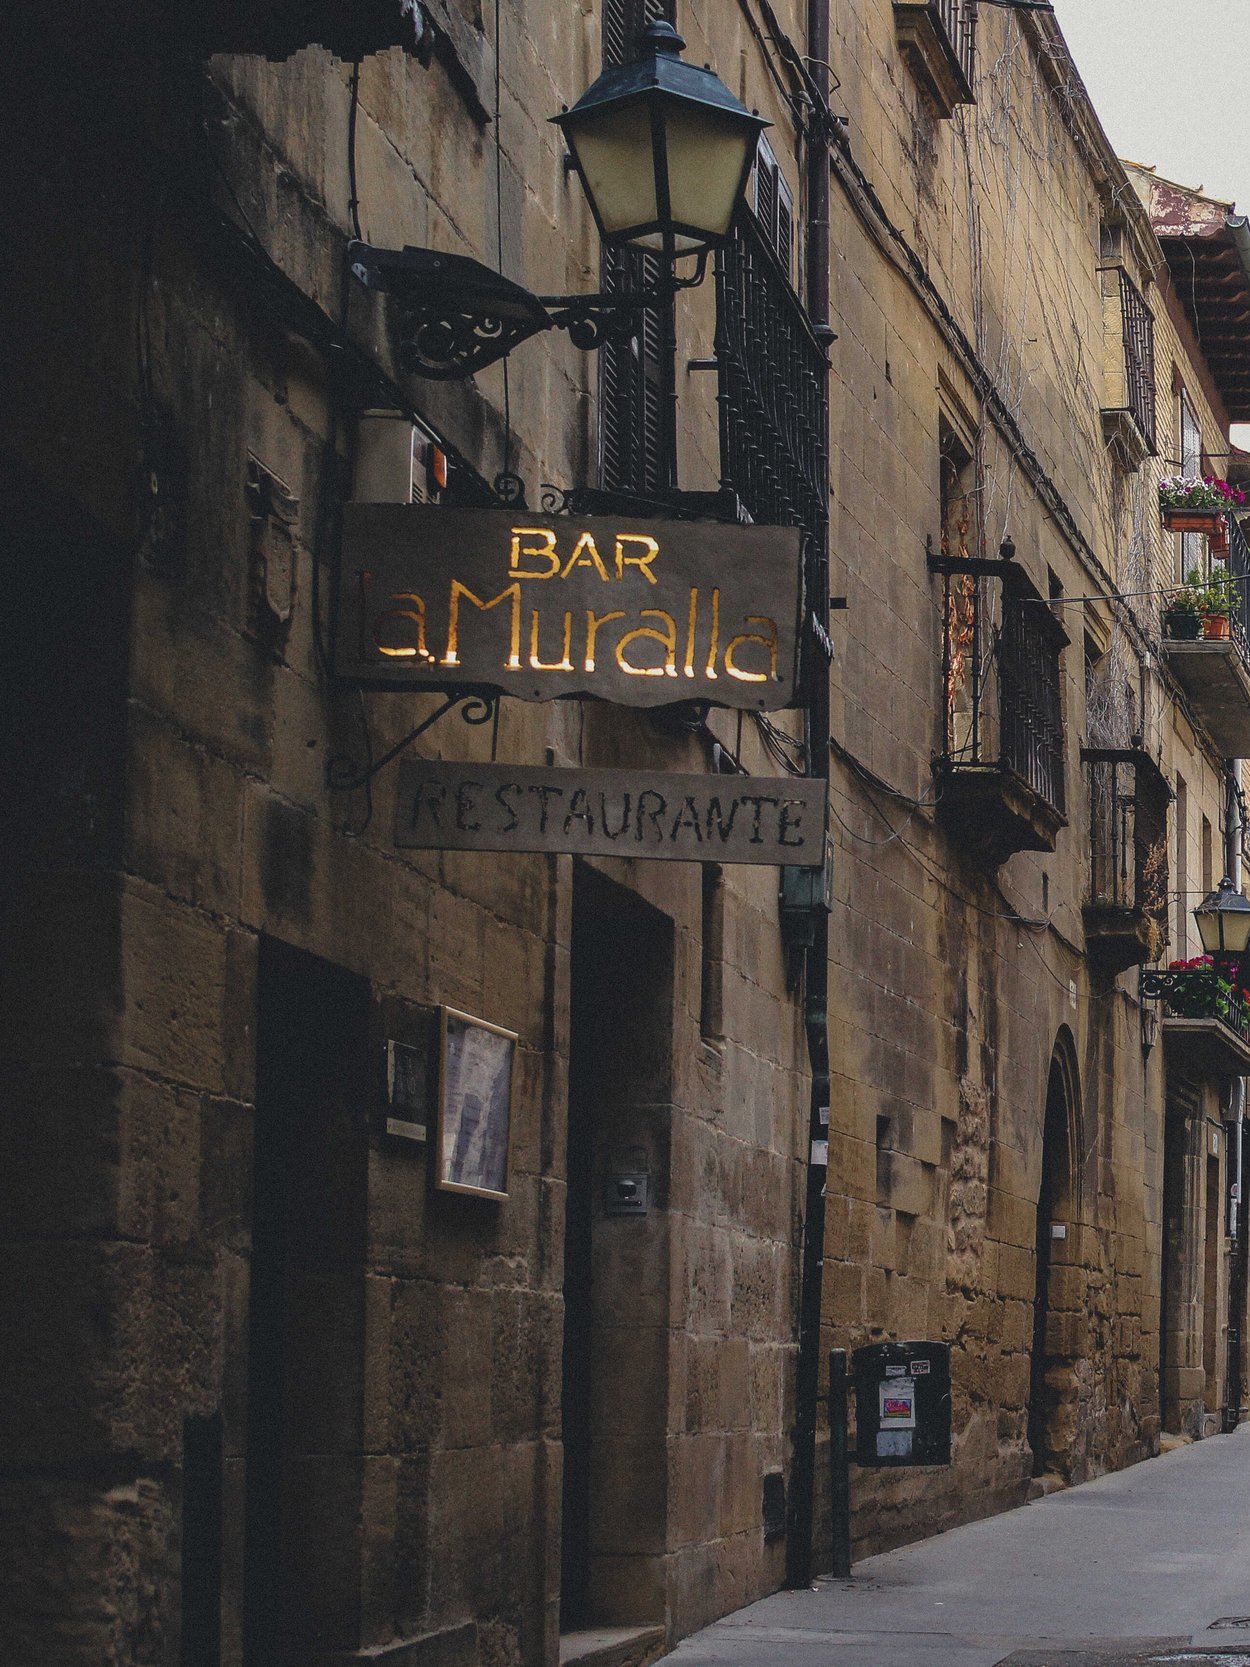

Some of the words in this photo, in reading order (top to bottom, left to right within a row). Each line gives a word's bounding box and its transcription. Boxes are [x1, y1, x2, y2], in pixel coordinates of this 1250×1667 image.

[508, 526, 660, 585] BAR
[439, 578, 785, 683] Muralla
[411, 778, 808, 848] RESTAURANTE
